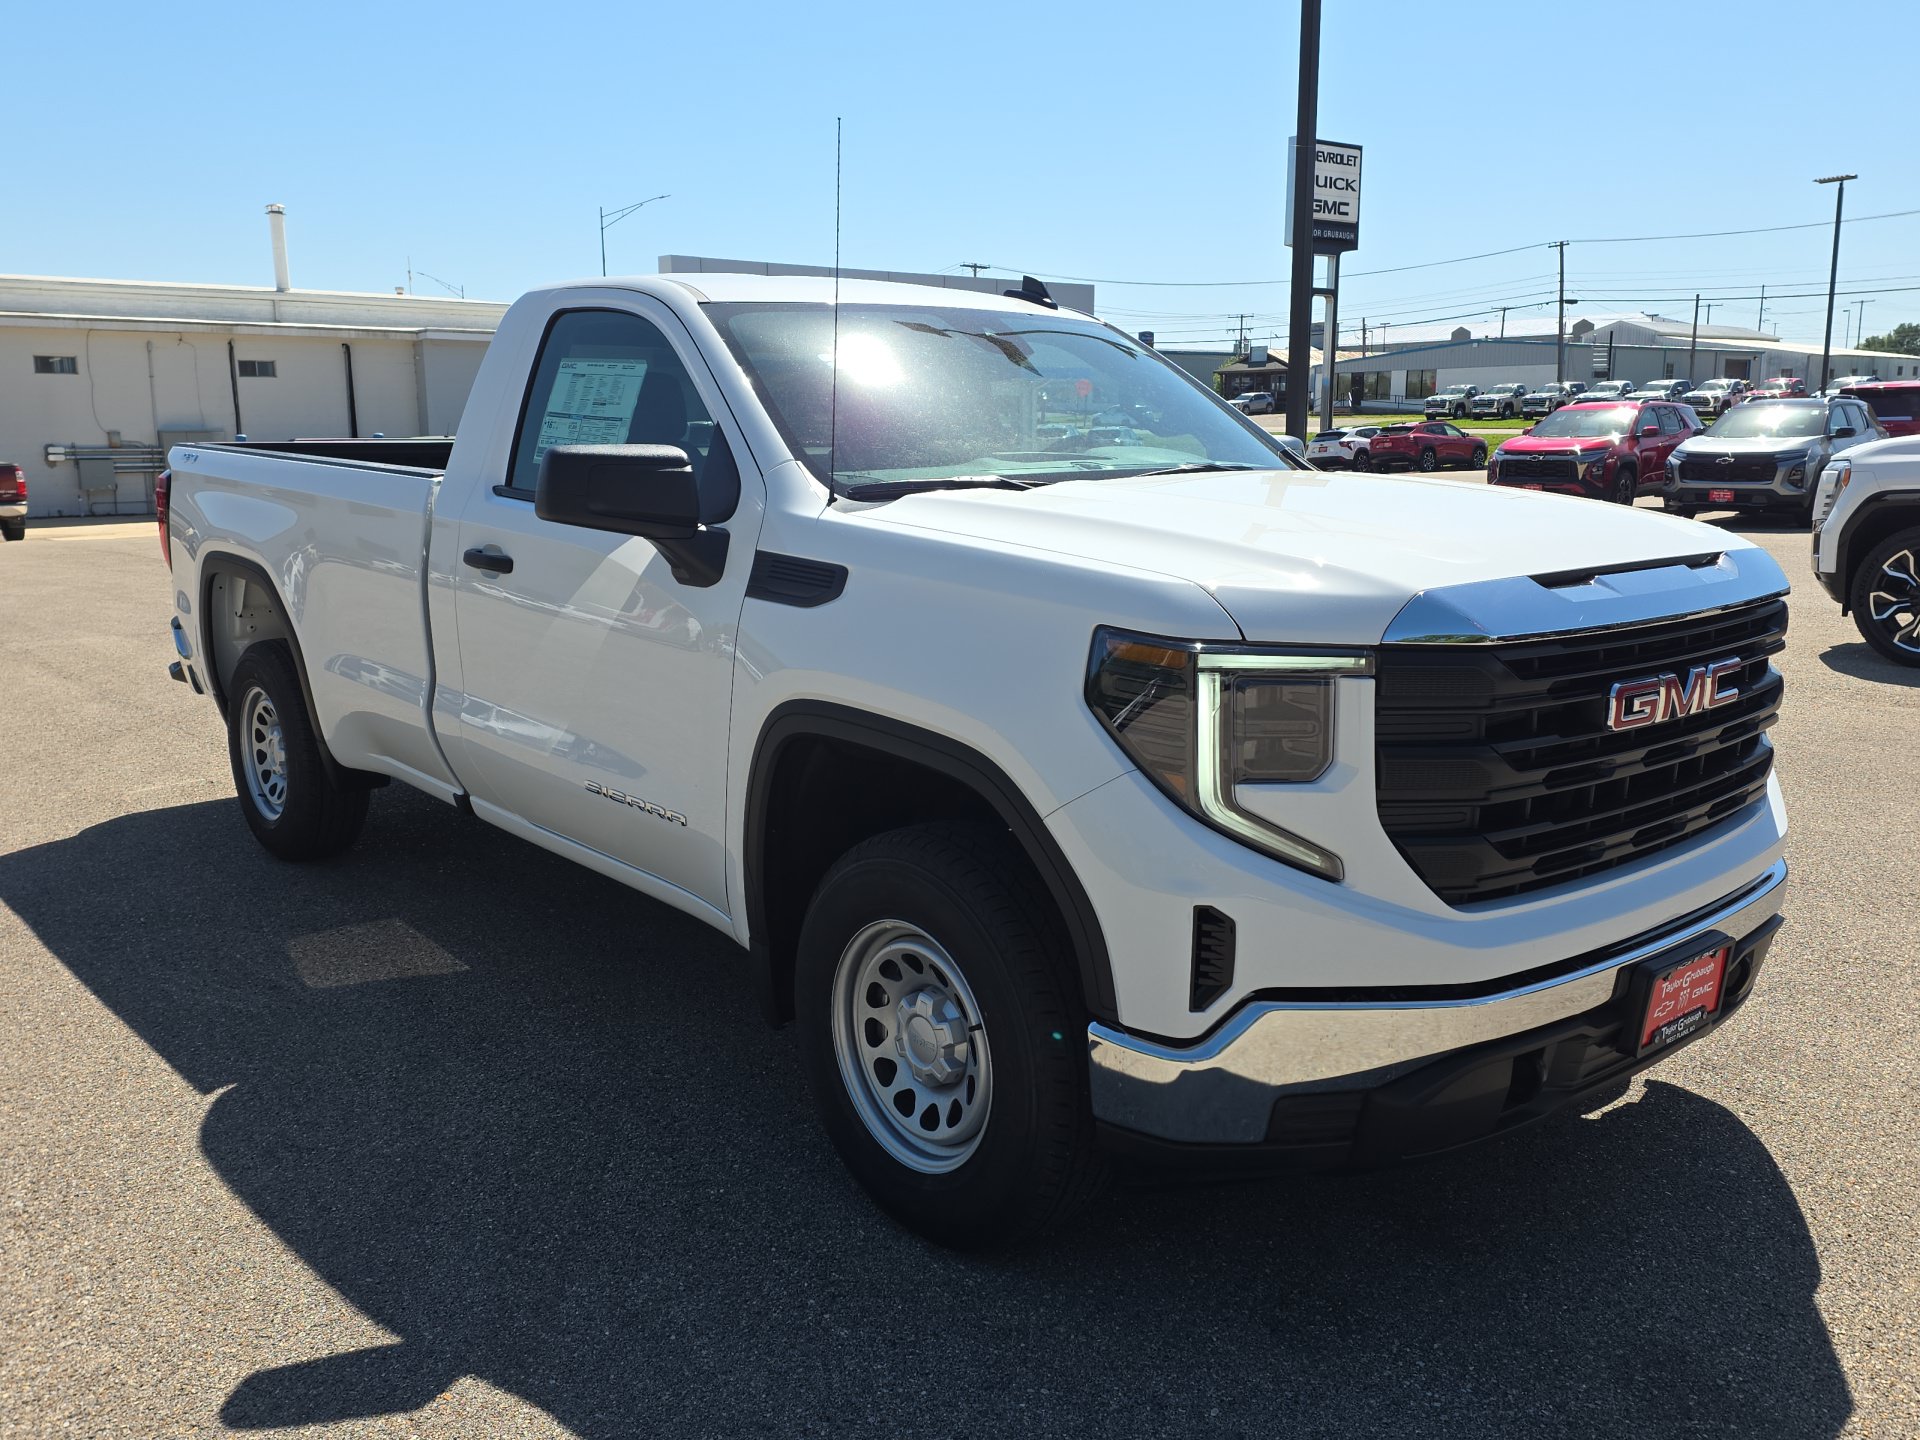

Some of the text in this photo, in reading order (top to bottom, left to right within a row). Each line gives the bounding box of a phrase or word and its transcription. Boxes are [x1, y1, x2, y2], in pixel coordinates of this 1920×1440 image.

[1316, 151, 1358, 167] EVROLET
[1315, 175, 1357, 192] UICK
[1313, 199, 1350, 216] GMC
[1607, 655, 1742, 731] GMC
[584, 779, 688, 827] SIERRA
[1662, 962, 1714, 998] Taylor Grubaugh
[1692, 981, 1713, 998] GMC
[1661, 1023, 1677, 1040] Taylor
[1677, 1011, 1702, 1031] Grubaugh
